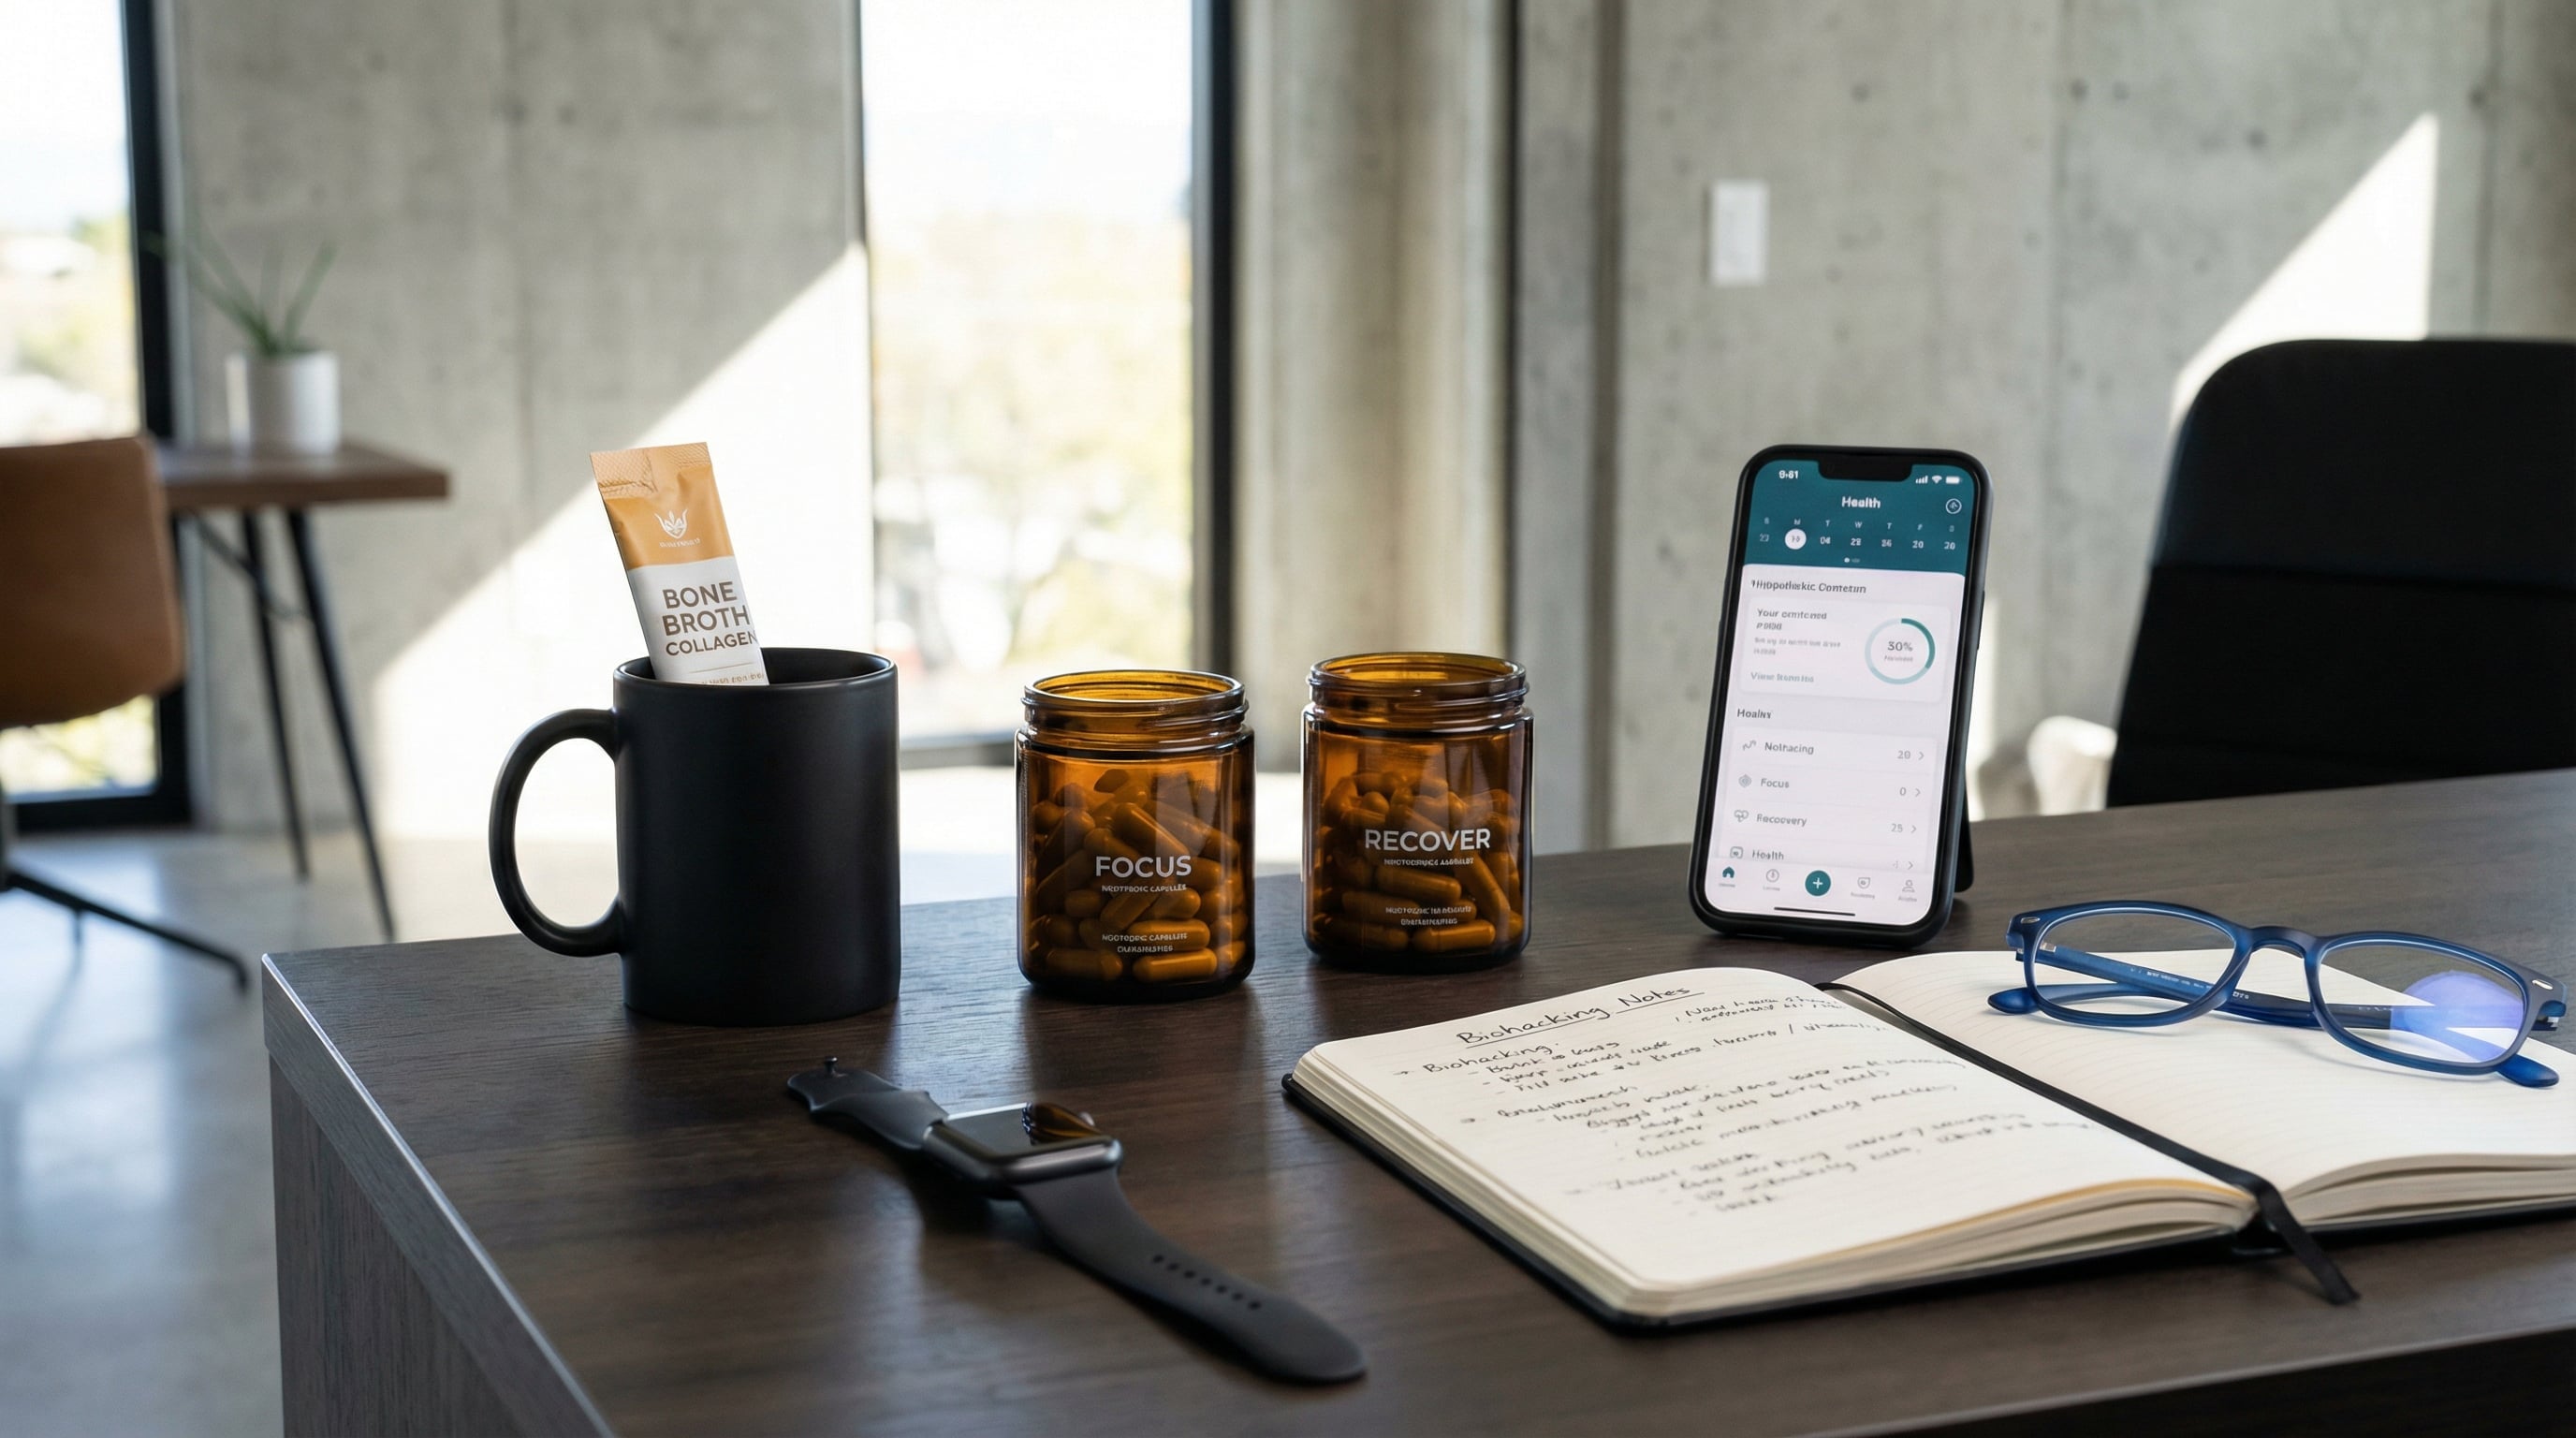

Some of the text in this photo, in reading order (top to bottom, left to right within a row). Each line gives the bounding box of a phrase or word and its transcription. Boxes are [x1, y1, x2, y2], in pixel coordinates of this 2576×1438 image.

[1841, 496, 1881, 509] Health
[662, 581, 737, 609] BONE
[662, 605, 751, 637] BROTH
[666, 630, 758, 656] COLLAGEN
[1887, 640, 1913, 653] 30%
[1897, 750, 1911, 760] 20
[1760, 778, 1790, 788] Focus
[1365, 828, 1491, 852] RECOVER
[1095, 855, 1193, 878] FOCUS
[1456, 986, 1691, 1044] Biohacking Notes
